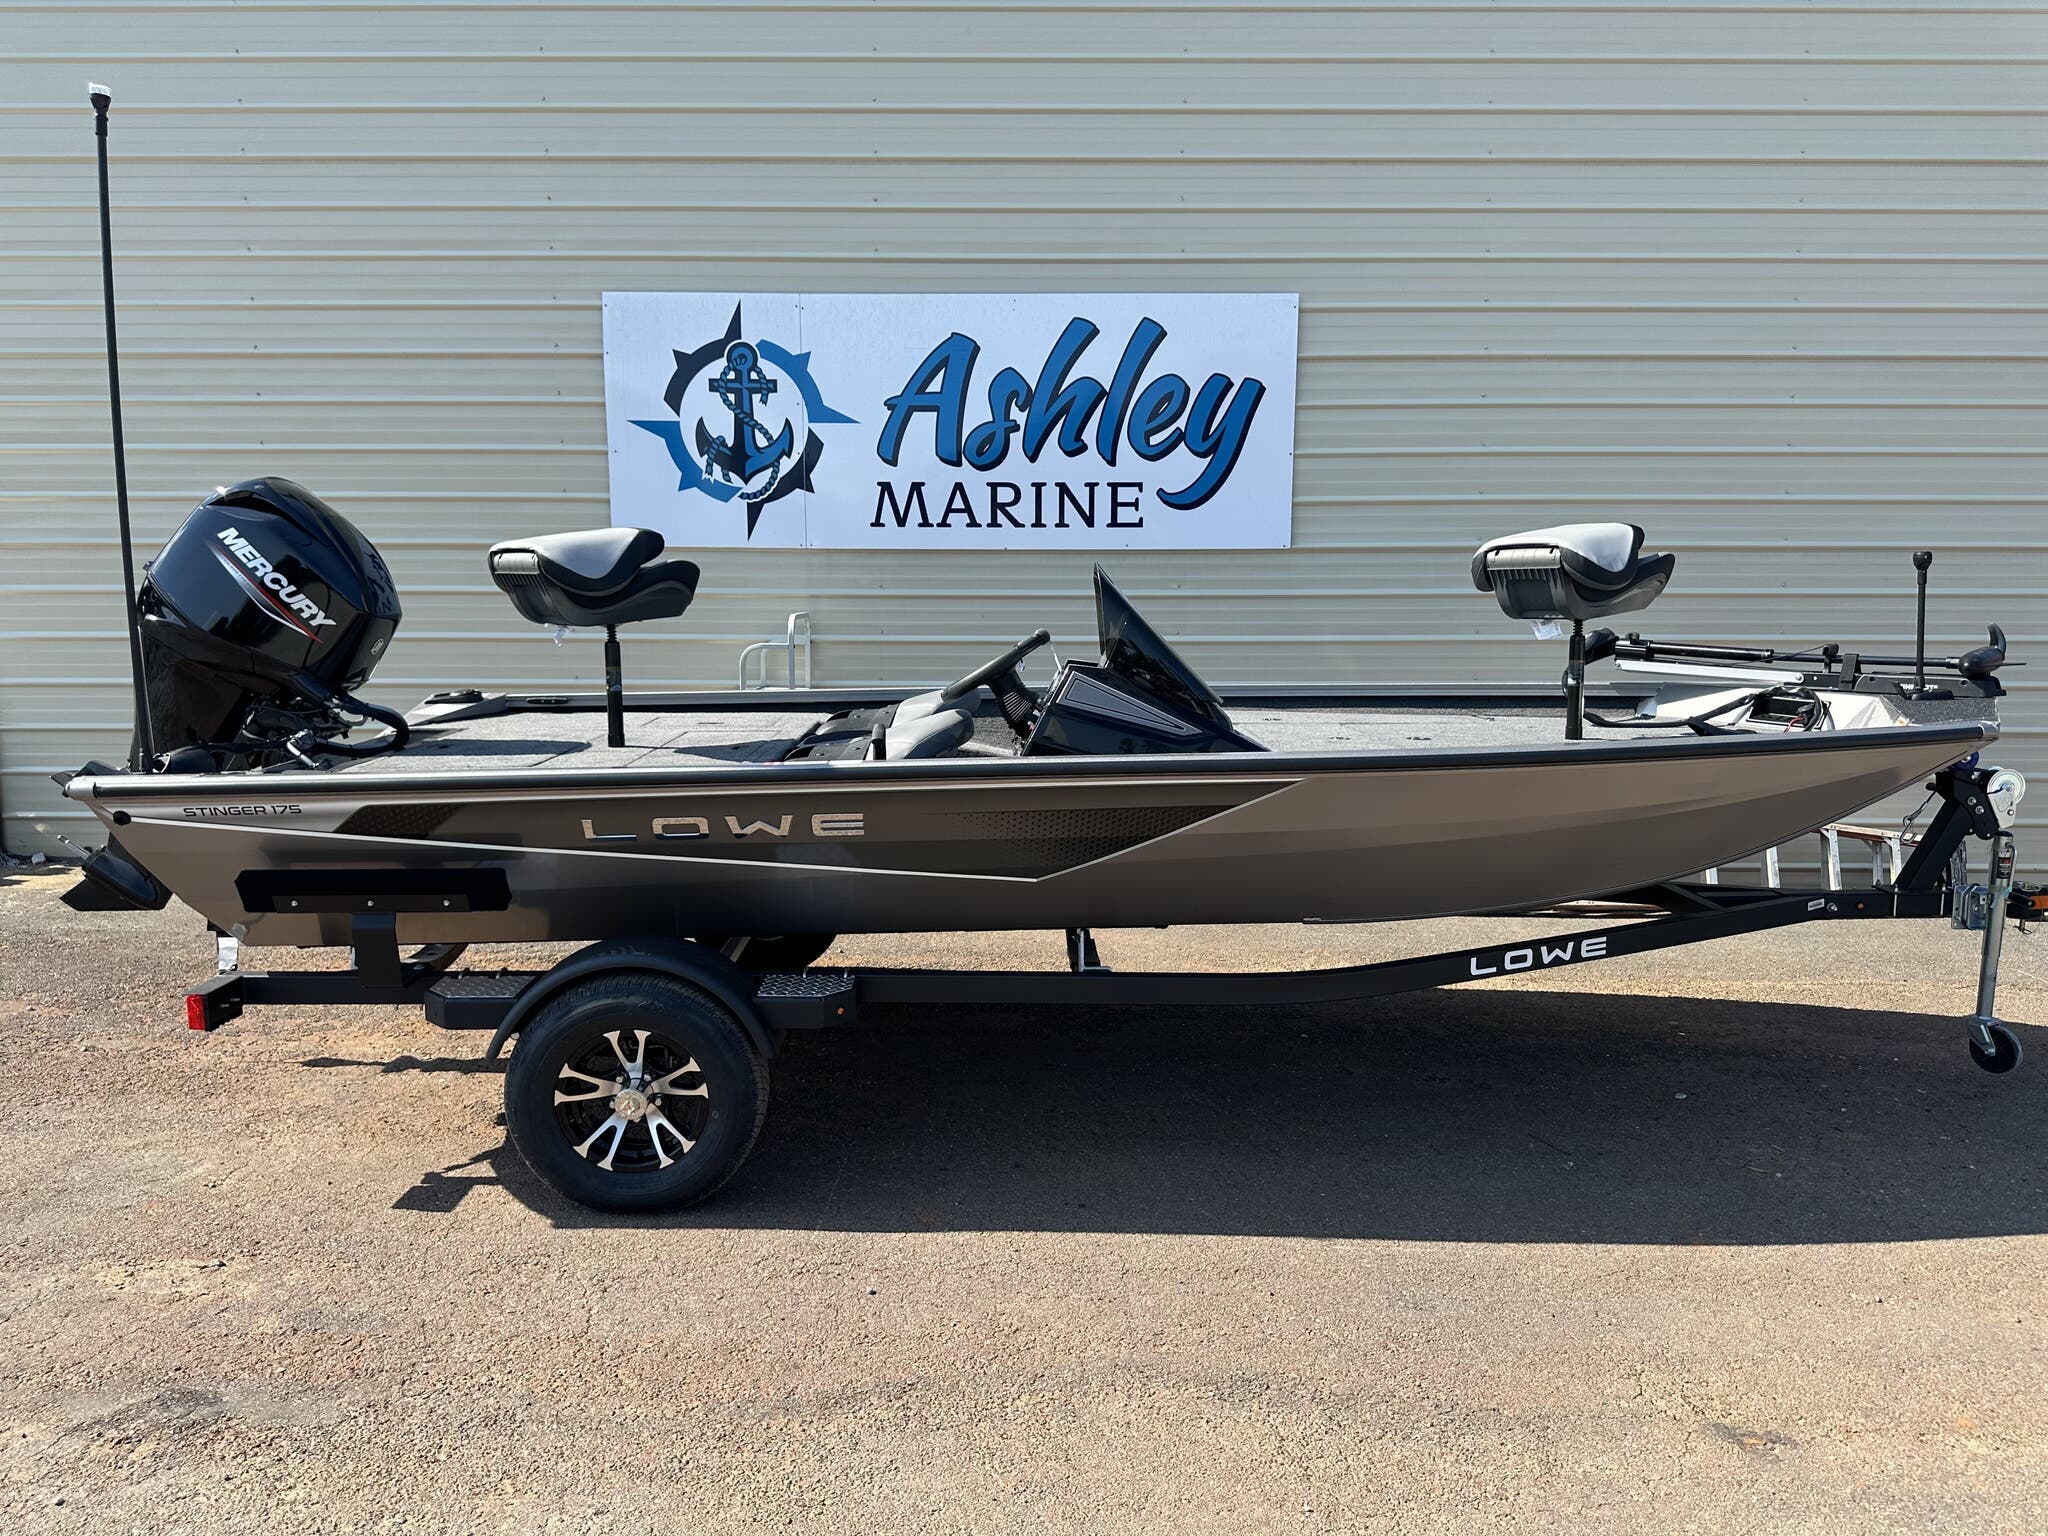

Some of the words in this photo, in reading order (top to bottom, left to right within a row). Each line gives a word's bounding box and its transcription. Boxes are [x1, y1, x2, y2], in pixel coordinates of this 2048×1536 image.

[876, 316, 1267, 511] Ashley
[869, 481, 1144, 528] MARINE
[216, 526, 337, 627] MERCURY
[183, 805, 268, 817] STINGER
[270, 804, 302, 815] 175
[582, 812, 865, 840] LOWE
[1470, 936, 1607, 976] LOWE
